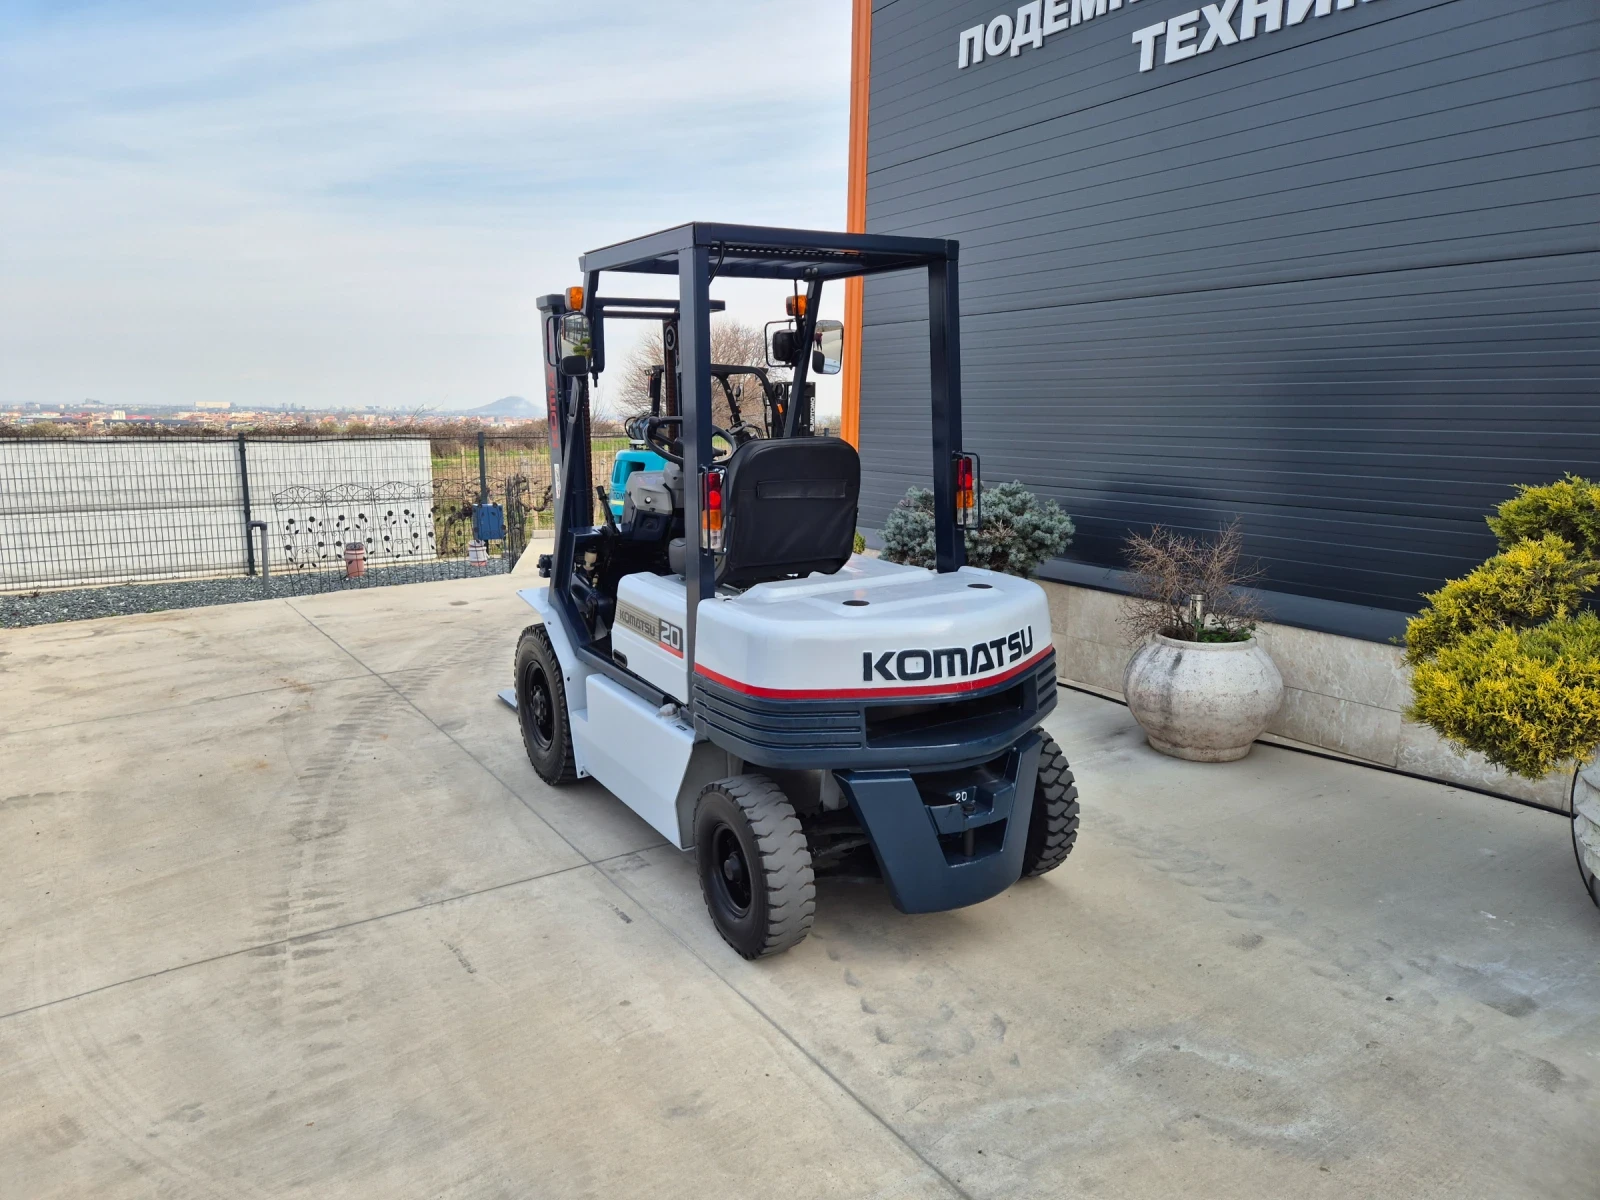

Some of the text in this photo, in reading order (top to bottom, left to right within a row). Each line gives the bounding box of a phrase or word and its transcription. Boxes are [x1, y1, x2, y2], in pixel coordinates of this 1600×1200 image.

[958, 0, 1141, 69] ПОДЕ
[1132, 0, 1374, 72] ТЕХН
[619, 609, 681, 650] KOMATSU 20
[862, 625, 1033, 682] KOMATSU
[955, 791, 968, 803] 20
